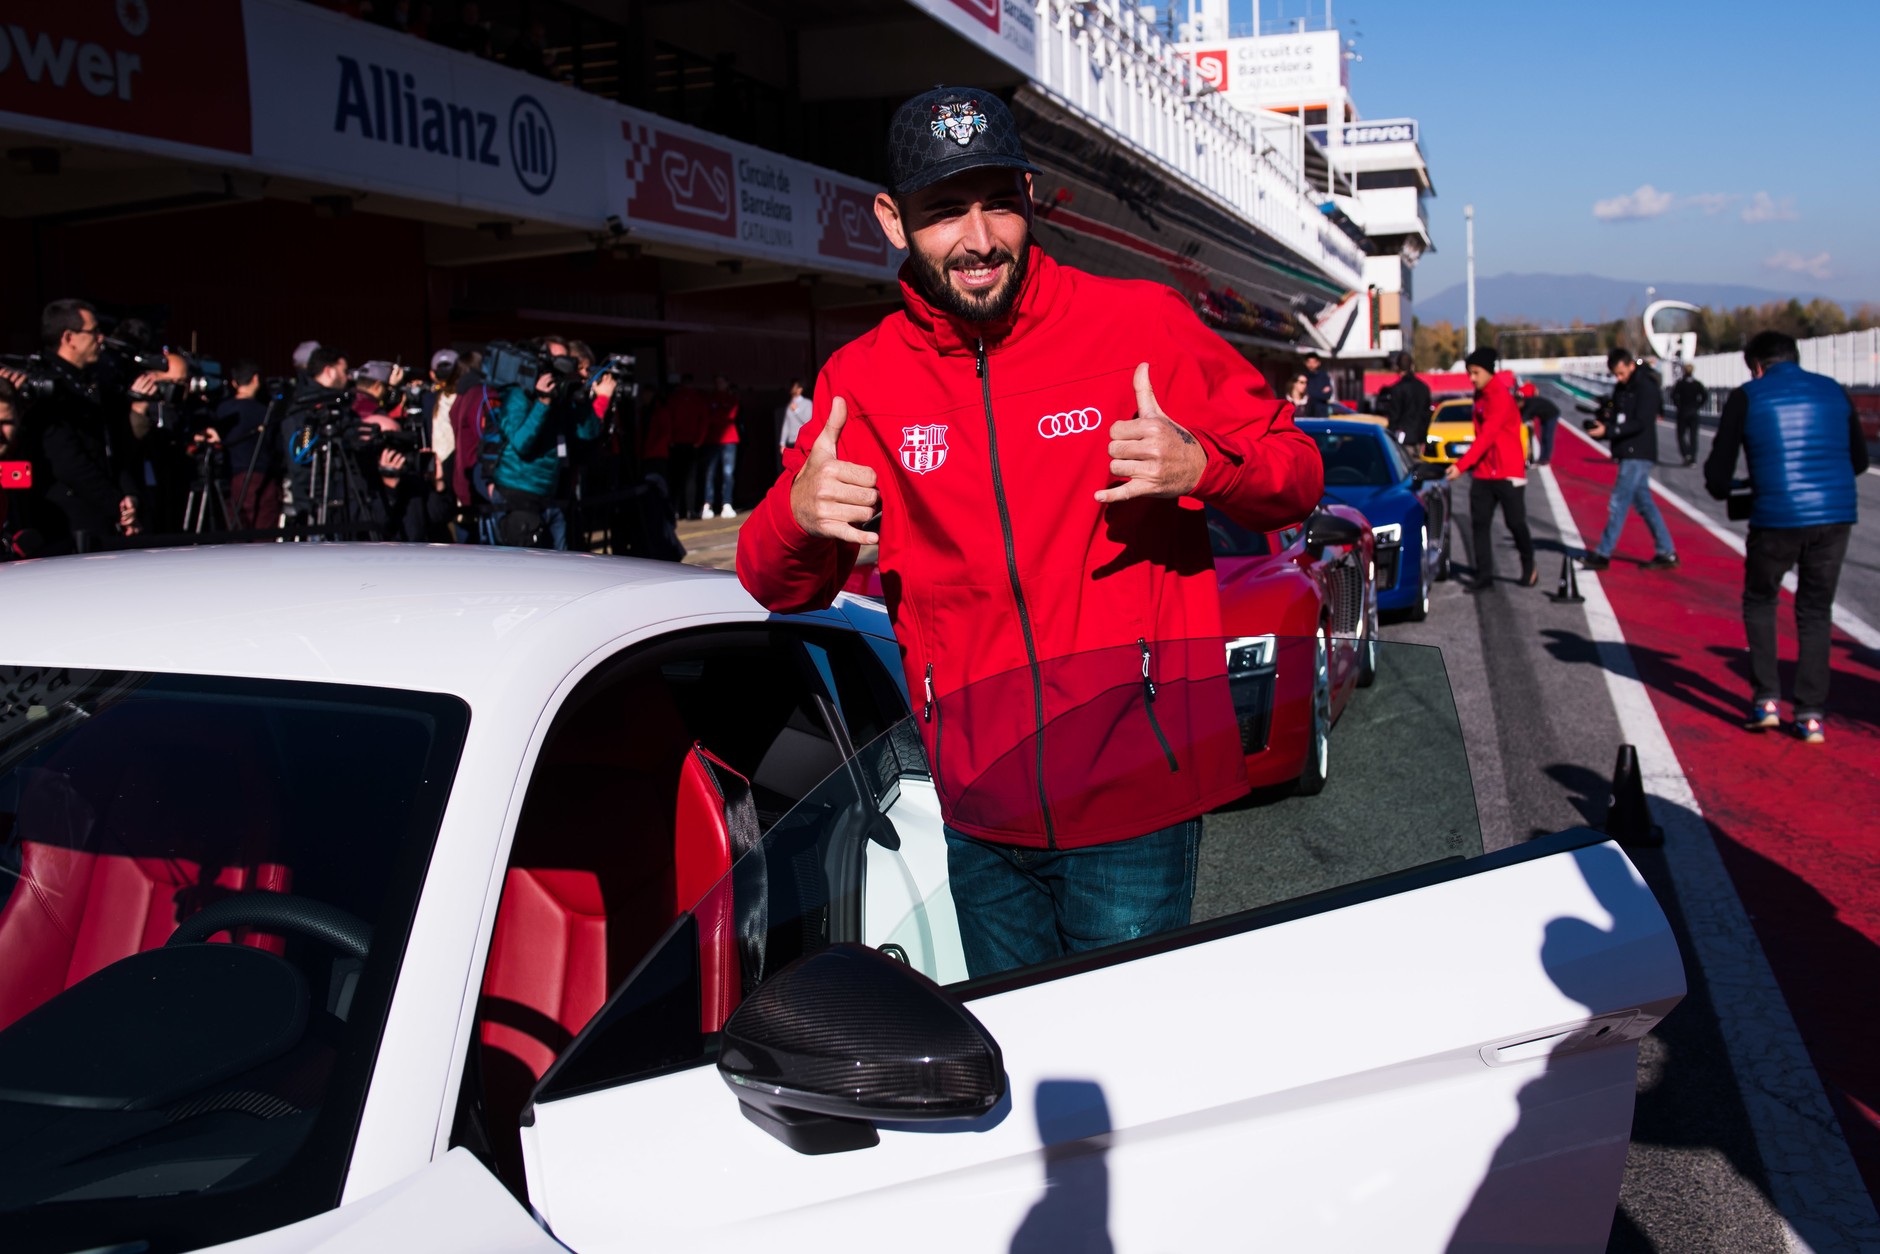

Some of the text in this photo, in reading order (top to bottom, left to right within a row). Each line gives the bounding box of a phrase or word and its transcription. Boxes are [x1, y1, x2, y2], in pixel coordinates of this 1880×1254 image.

[1238, 44, 1291, 60] Cicuit
[334, 54, 500, 167] Allianz
[1346, 126, 1411, 142] REPSOL
[739, 158, 789, 193] Circuit de
[741, 189, 792, 222] Barcelona
